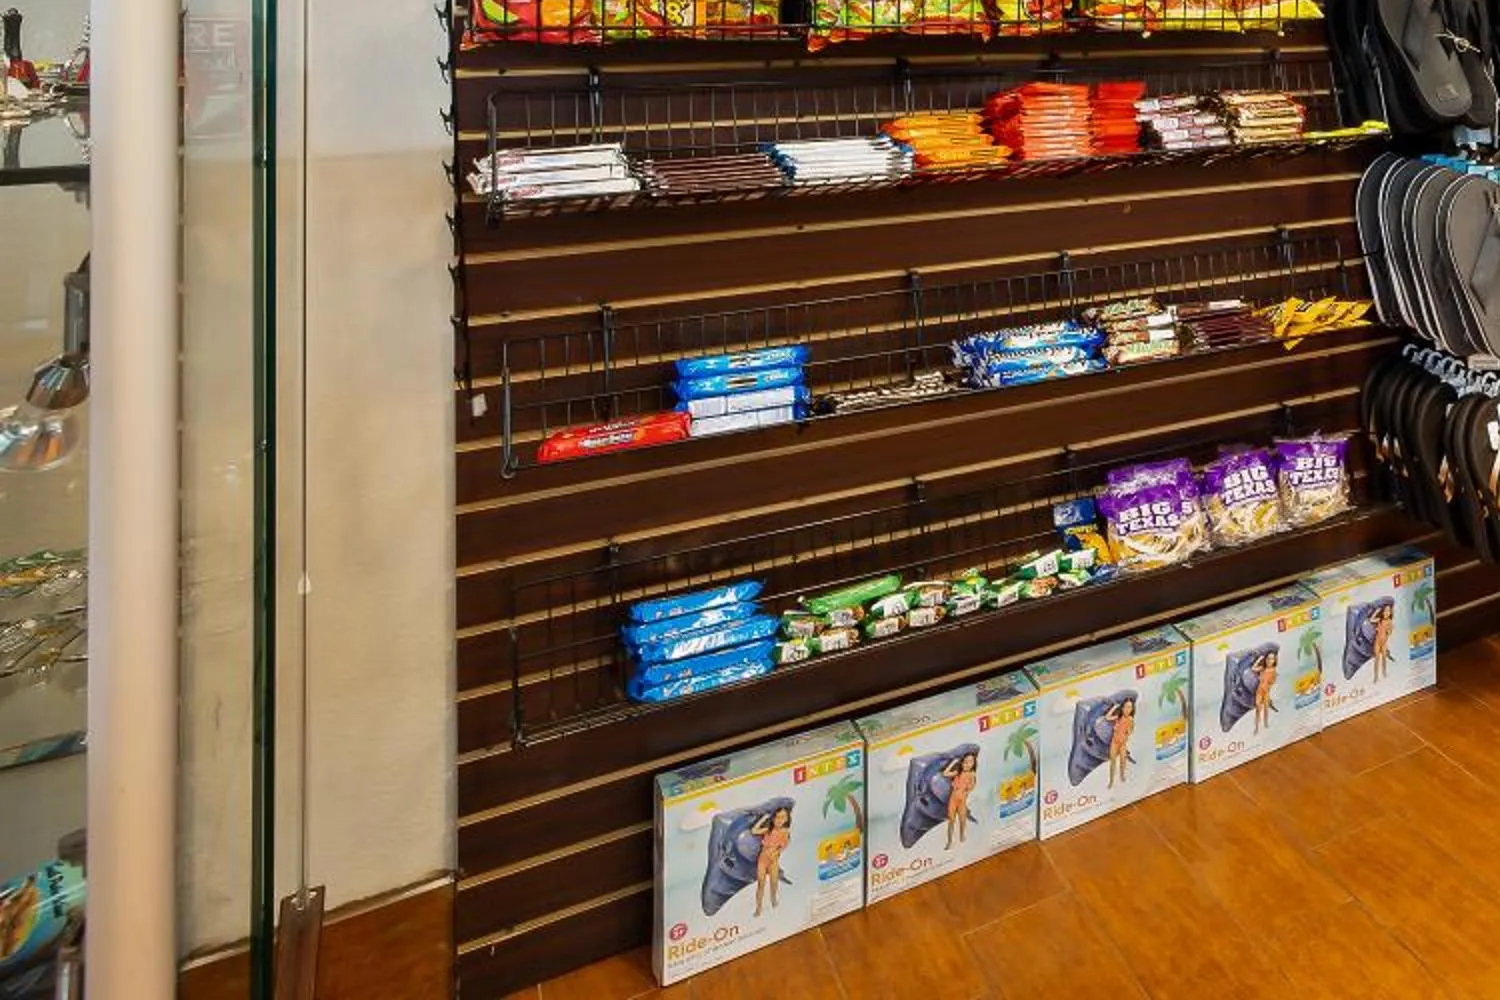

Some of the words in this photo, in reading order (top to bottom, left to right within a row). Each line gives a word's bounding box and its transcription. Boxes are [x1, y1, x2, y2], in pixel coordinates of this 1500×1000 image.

[1295, 455, 1338, 472] BIG
[1223, 464, 1268, 490] BIG
[1223, 478, 1277, 506] TEXAS
[1116, 513, 1181, 536] TEXAS
[1119, 501, 1171, 523] BIG
[1043, 794, 1097, 821] Ride-On
[871, 856, 933, 887] Ride-On
[668, 925, 740, 960] Ride-On
